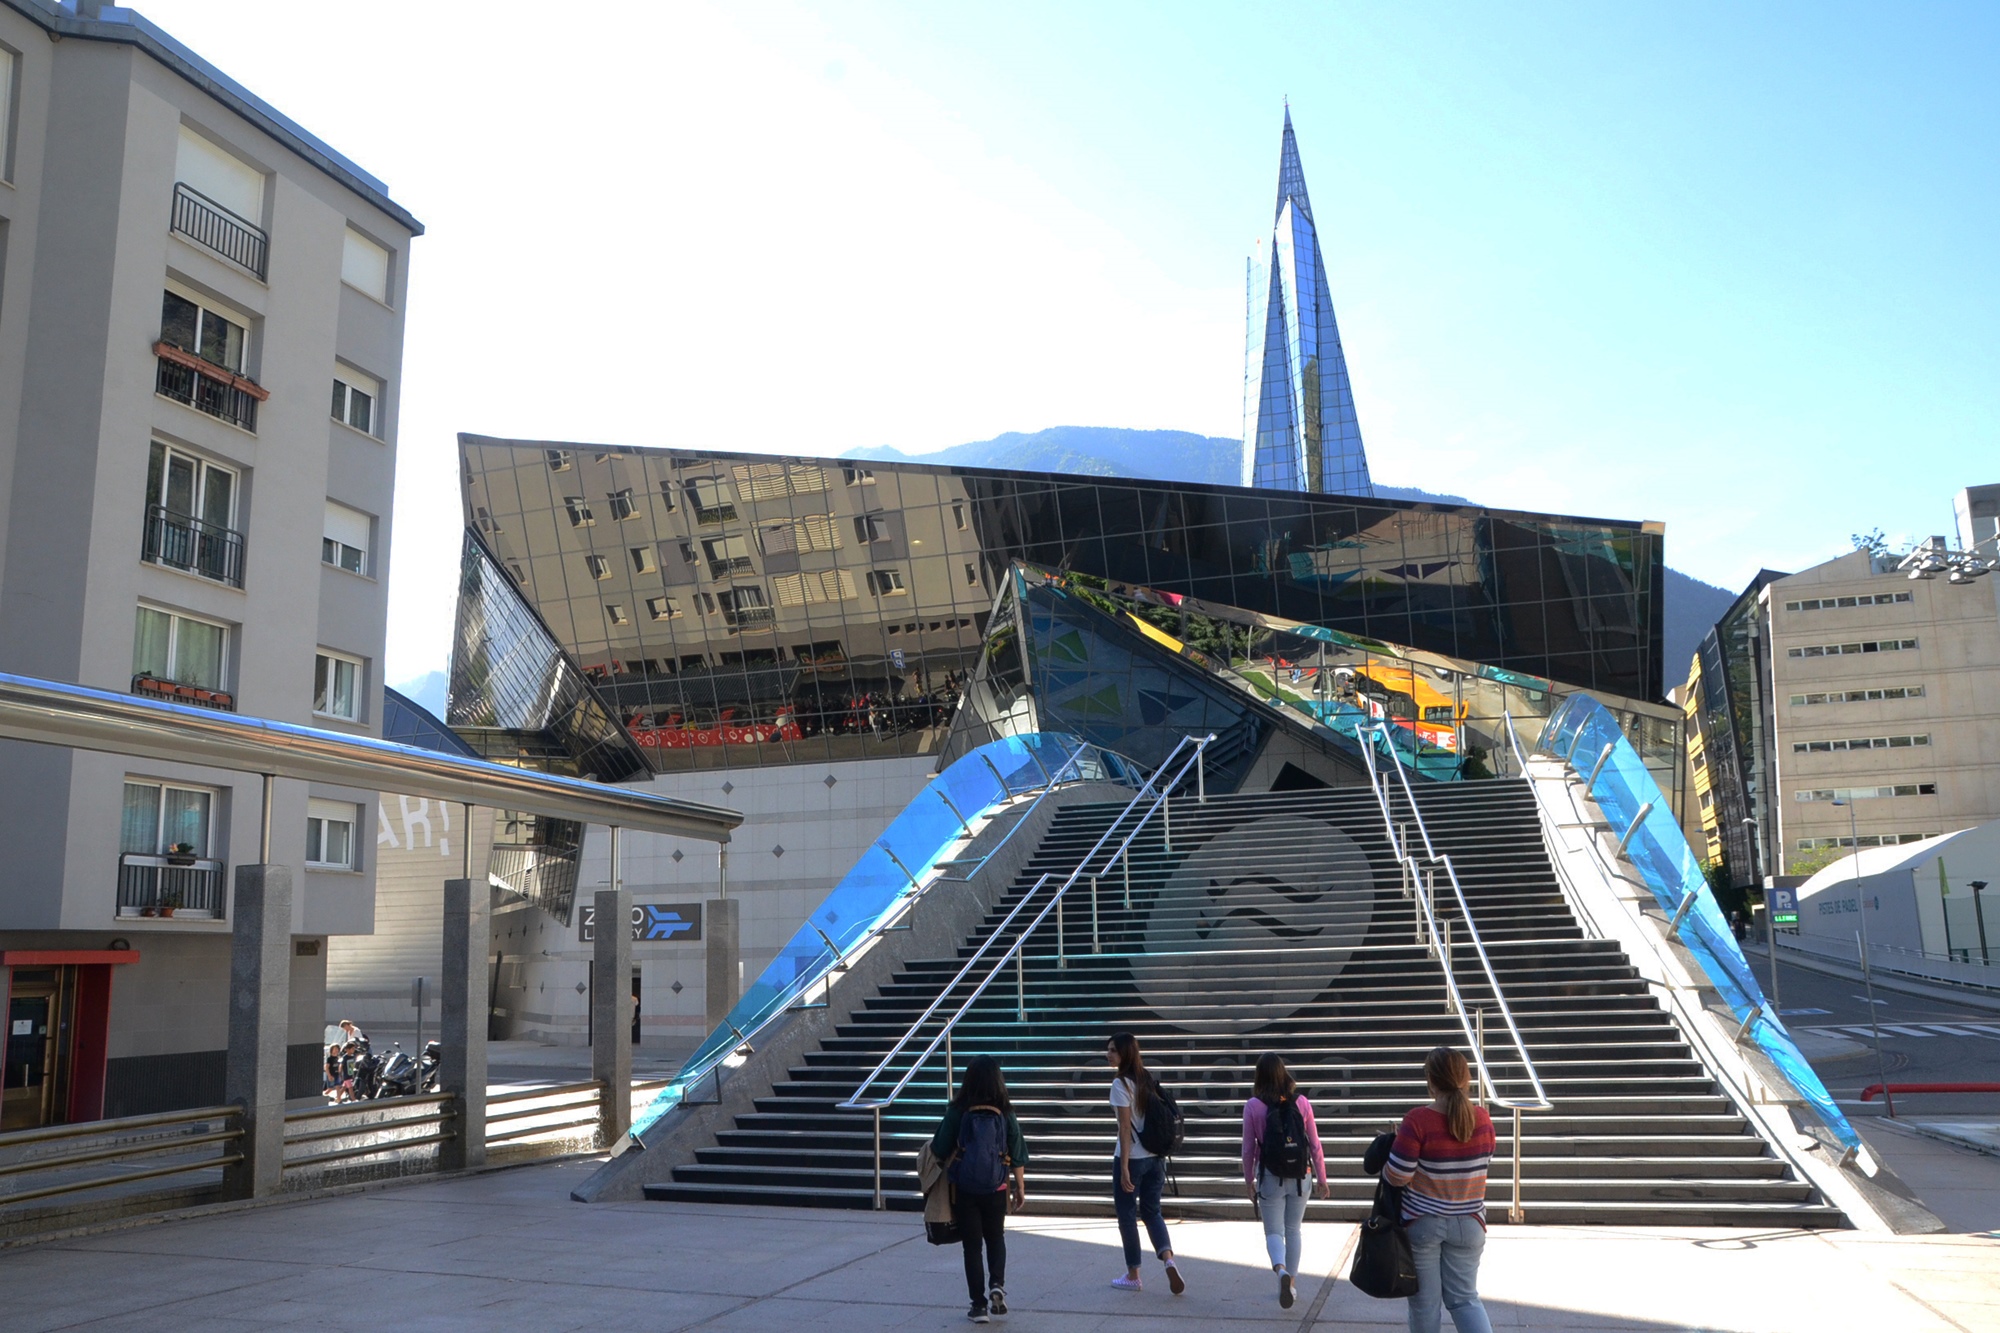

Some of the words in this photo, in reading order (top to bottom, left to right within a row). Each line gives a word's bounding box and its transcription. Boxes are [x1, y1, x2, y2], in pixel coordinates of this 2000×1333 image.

[1776, 891, 1791, 909] P
[1819, 901, 1834, 915] PISTES
[584, 907, 644, 925] ZO
